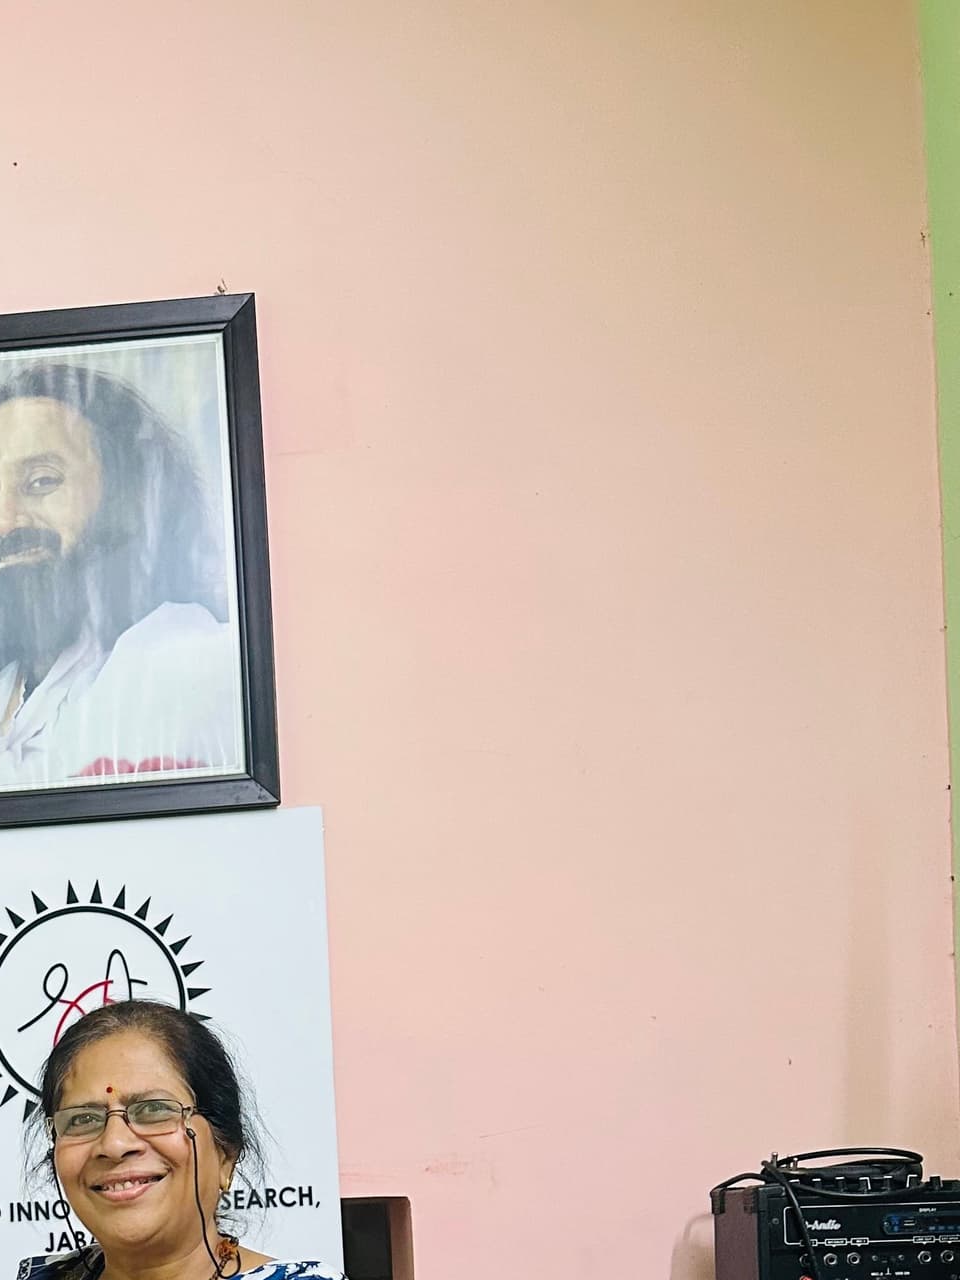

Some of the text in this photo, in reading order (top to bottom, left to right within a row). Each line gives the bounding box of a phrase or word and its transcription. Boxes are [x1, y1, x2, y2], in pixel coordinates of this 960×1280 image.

[10, 1200, 70, 1222] INNO
[220, 1186, 320, 1210] SEARCH,
[45, 1231, 98, 1252] JAB
